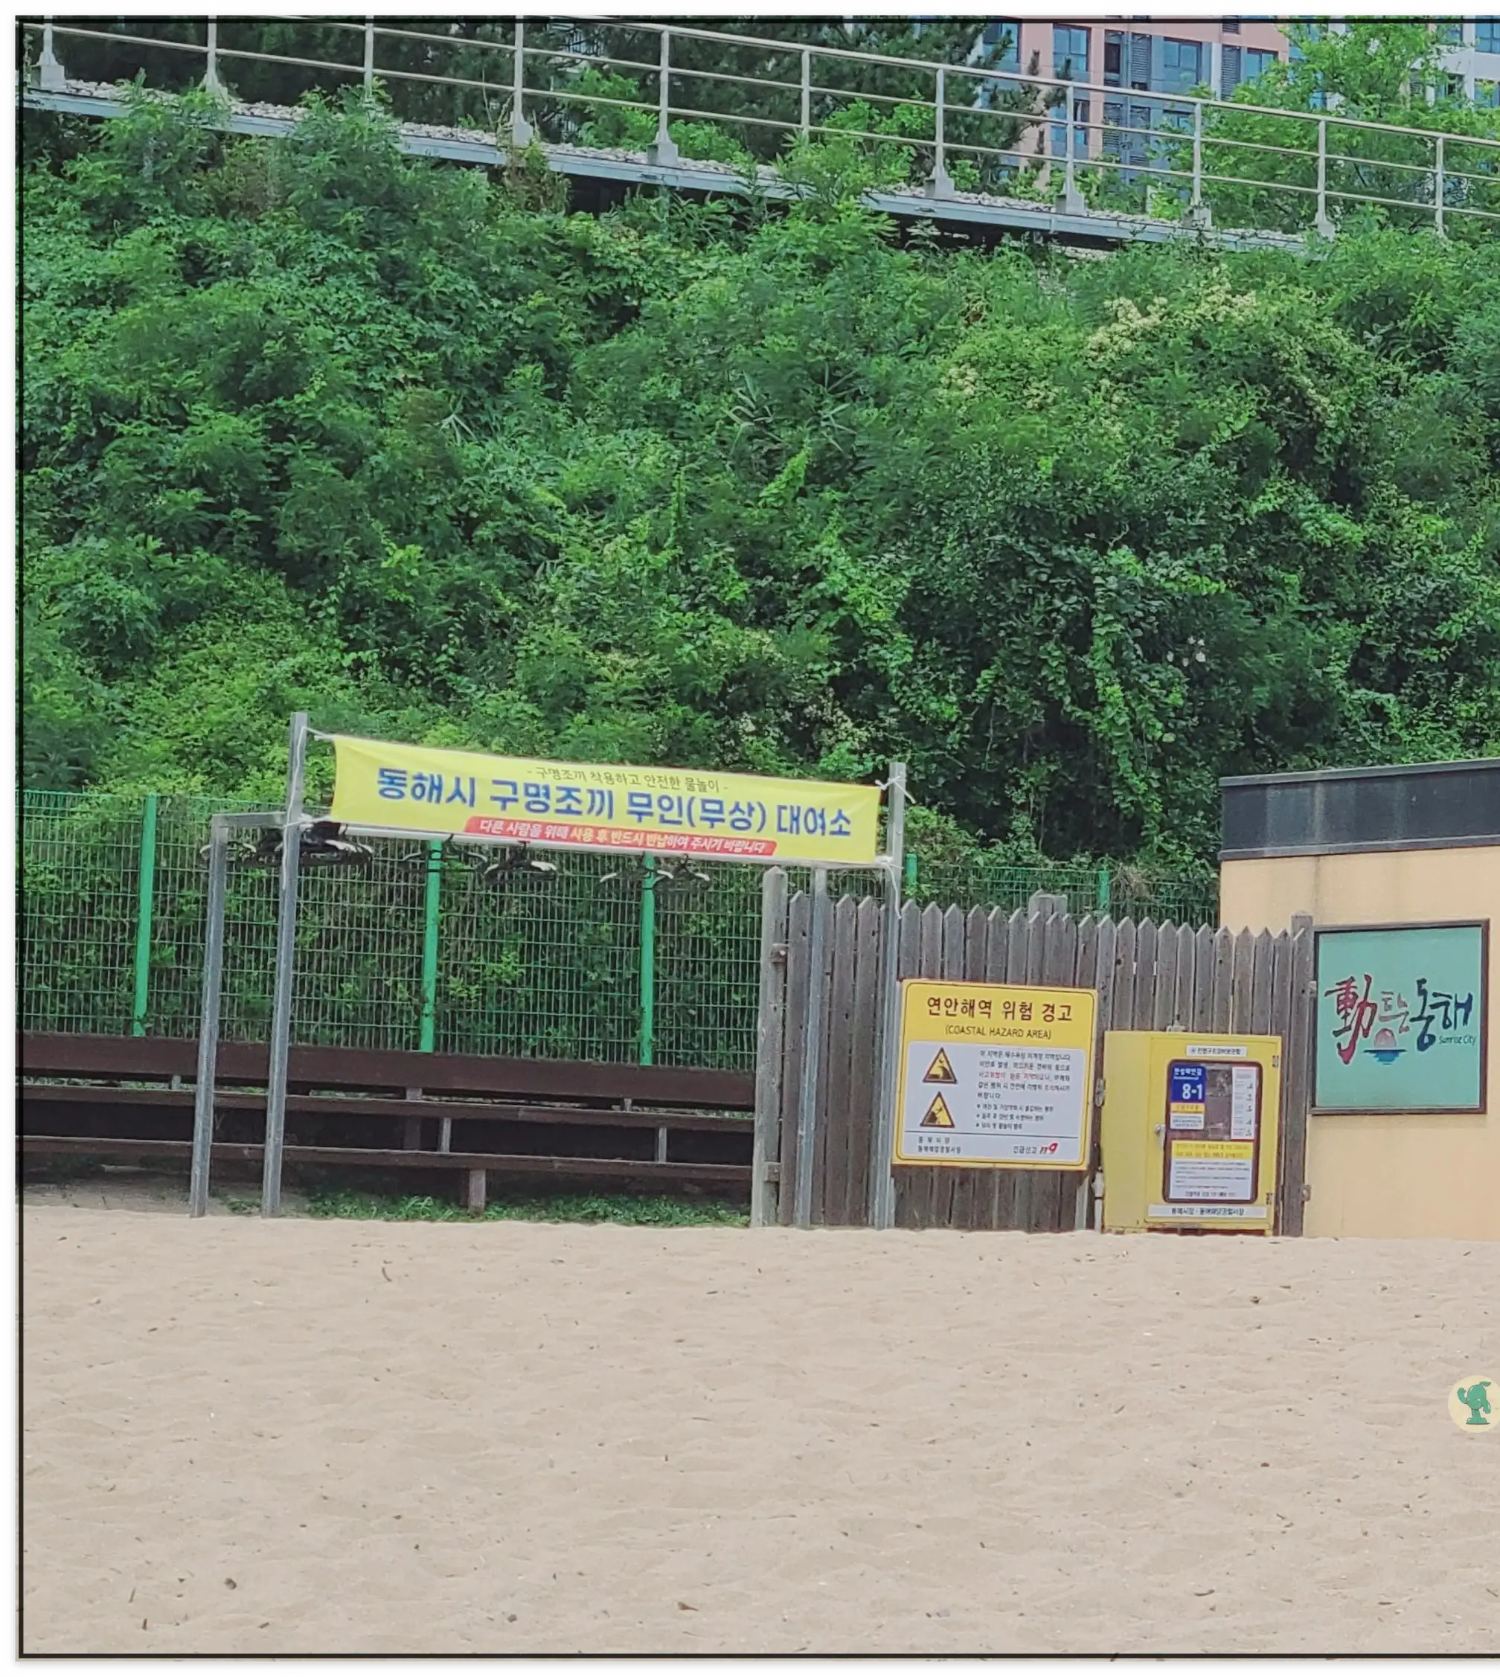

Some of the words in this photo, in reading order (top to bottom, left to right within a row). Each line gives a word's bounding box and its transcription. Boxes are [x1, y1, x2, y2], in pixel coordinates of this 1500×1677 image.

[536, 767, 587, 783] 구명조끼
[590, 772, 641, 787] 착용하고
[644, 775, 683, 790] 안전한
[685, 778, 720, 793] 물놀이
[378, 768, 476, 807] 동해시
[490, 780, 614, 820] 구명조끼
[627, 791, 767, 832] 무인(무상)
[777, 805, 851, 836] 대여소
[479, 819, 504, 834] 다른
[506, 822, 541, 837] 사람을
[570, 828, 593, 842] 사용
[596, 830, 607, 842] 후
[611, 831, 643, 846] 반드시
[646, 833, 687, 848] 반납하여
[690, 836, 722, 850] 주시기
[927, 997, 992, 1019] 연안해역
[1002, 1001, 1033, 1021] 위험
[1042, 1003, 1073, 1023] 경고
[945, 1024, 986, 1036] (COASTAL
[989, 1027, 1024, 1038] HAZARD
[1026, 1029, 1051, 1040] AREA)
[1182, 1083, 1203, 1100] 8-1
